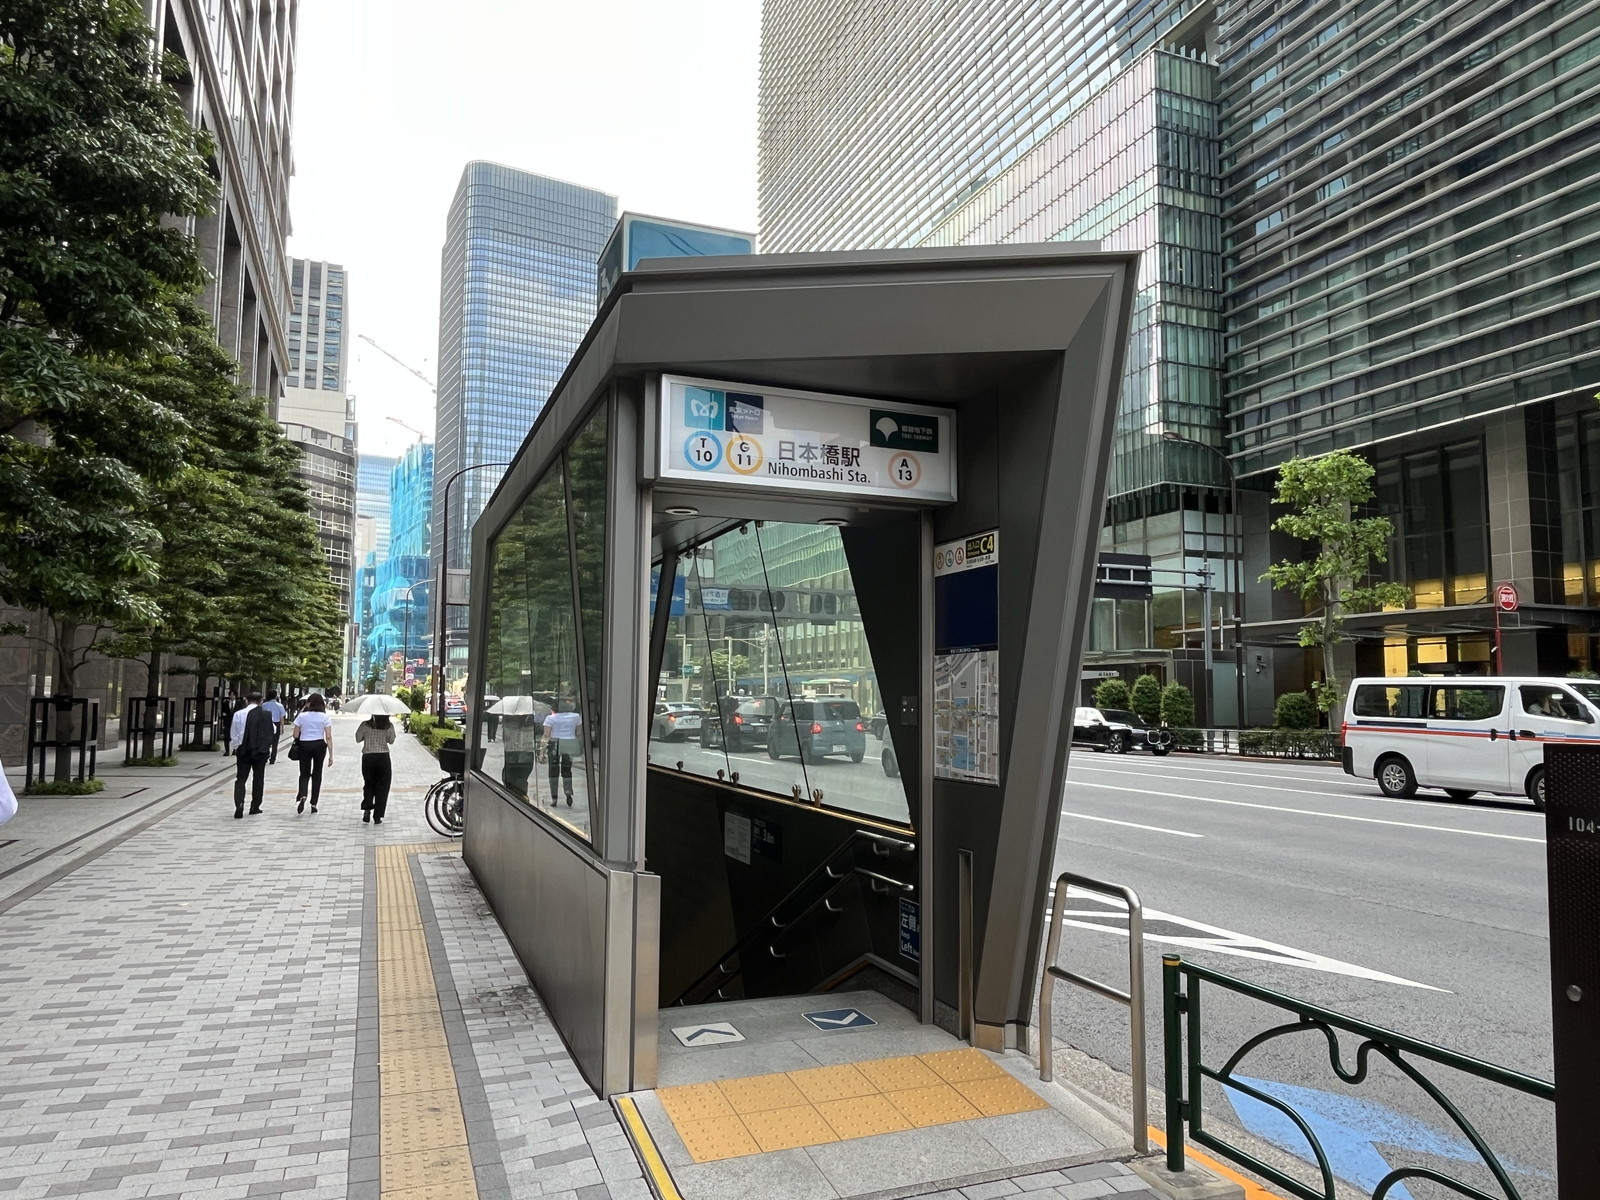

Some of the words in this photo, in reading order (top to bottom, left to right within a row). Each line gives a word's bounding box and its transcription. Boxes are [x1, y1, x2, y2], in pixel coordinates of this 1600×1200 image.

[700, 438, 707, 448] T
[740, 442, 750, 452] G
[696, 450, 712, 462] 10
[737, 454, 752, 466] 11
[778, 440, 860, 468] 日本橋駅
[900, 458, 908, 468] A
[768, 462, 844, 482] Nihombashi
[848, 469, 870, 484] Sta.
[898, 470, 912, 482] 13
[980, 536, 993, 553] C4
[902, 940, 912, 953] Left
